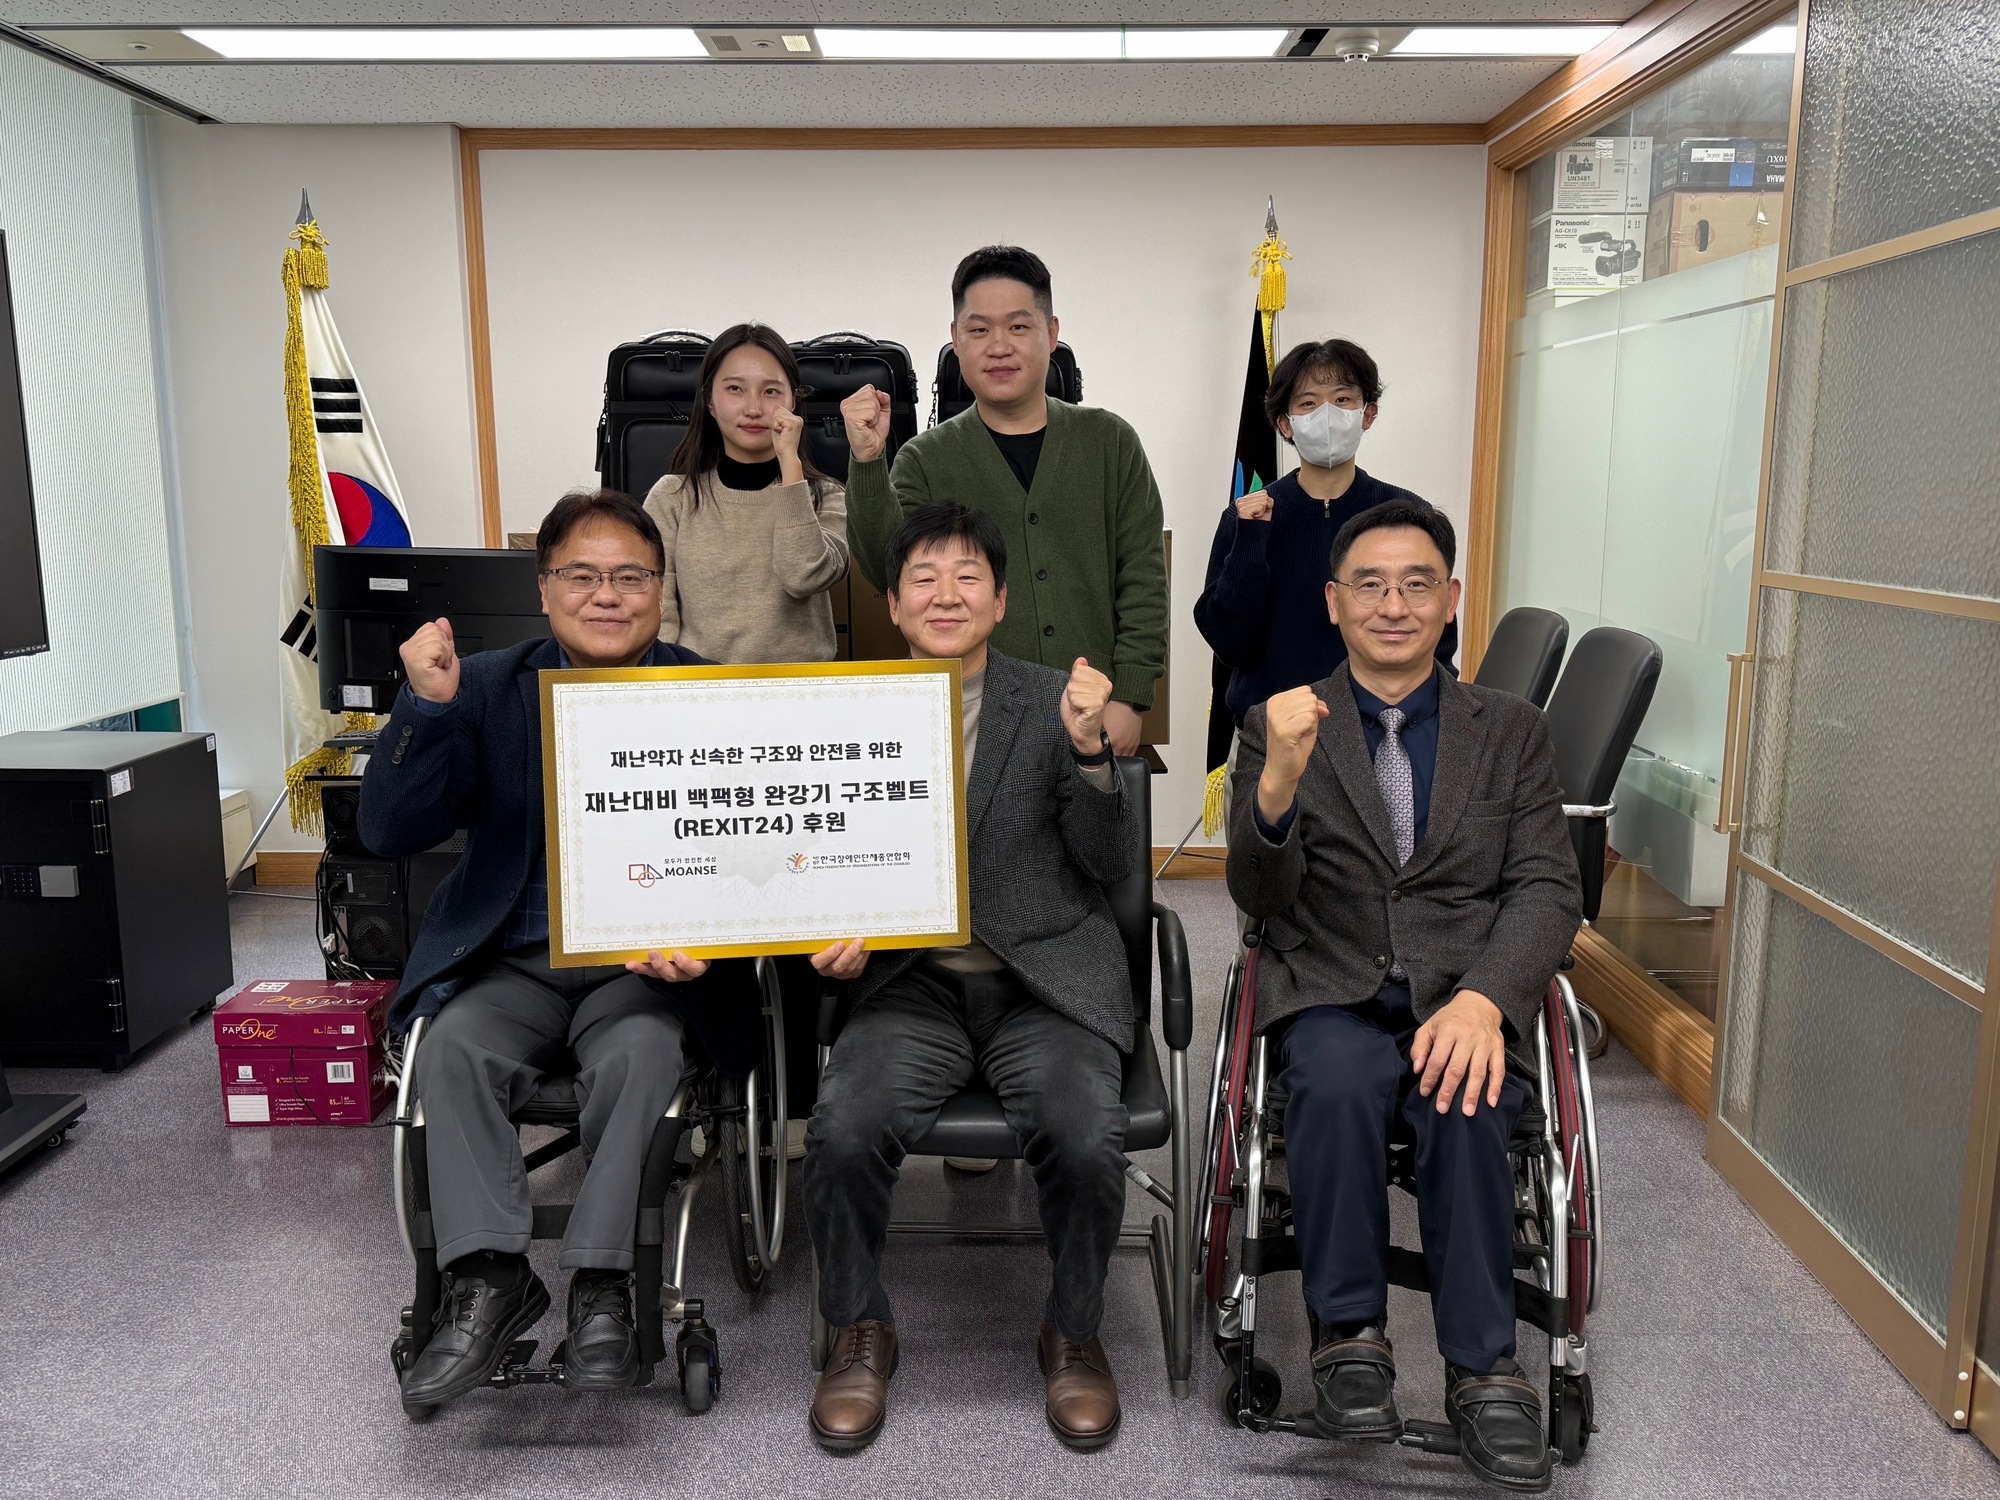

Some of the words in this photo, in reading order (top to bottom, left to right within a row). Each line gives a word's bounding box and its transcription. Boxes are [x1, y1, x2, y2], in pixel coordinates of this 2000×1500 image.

[610, 748, 685, 769] 재난약자
[689, 746, 745, 766] 신속한
[749, 744, 804, 764] 구조와
[809, 742, 862, 762] 안전을
[868, 741, 903, 760] 위한
[584, 789, 678, 814] 재난대비
[687, 786, 756, 809] 백팩형
[764, 783, 832, 807] 완강기
[840, 779, 930, 804] 구조벨트
[674, 813, 794, 840] (REXIT24)
[802, 811, 847, 834] 후원
[665, 865, 718, 877] MOANSE
[222, 1026, 254, 1035] PAPER
